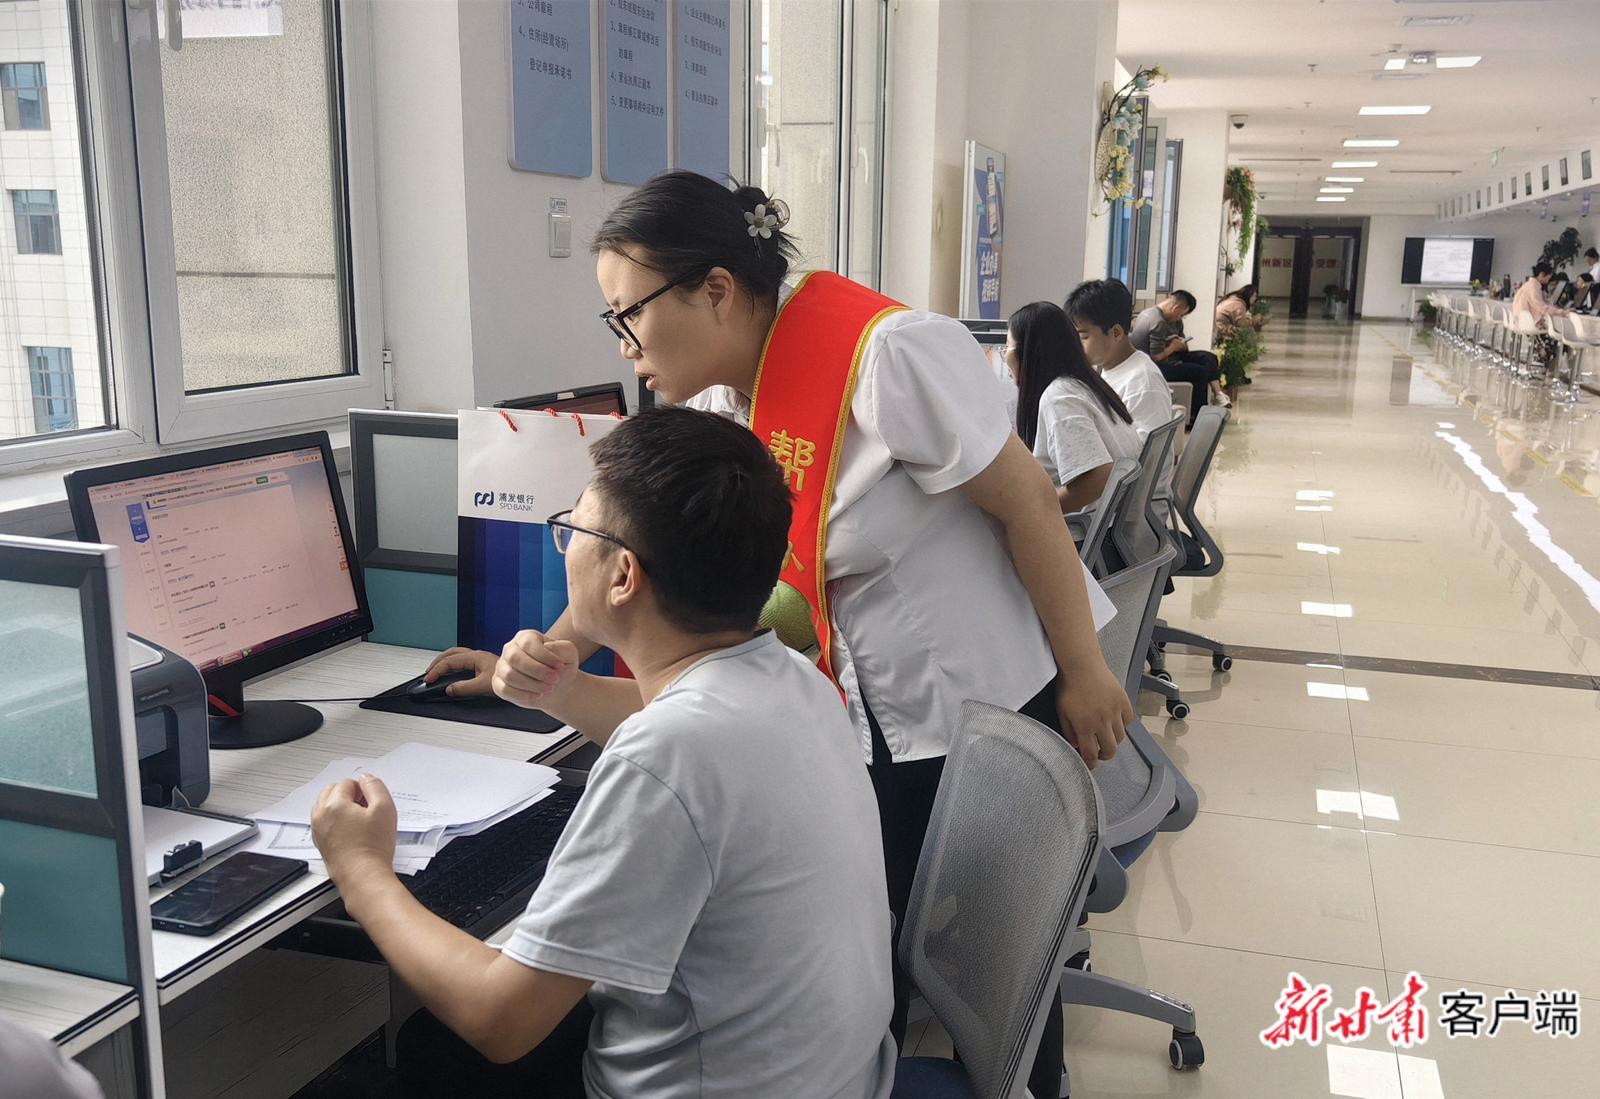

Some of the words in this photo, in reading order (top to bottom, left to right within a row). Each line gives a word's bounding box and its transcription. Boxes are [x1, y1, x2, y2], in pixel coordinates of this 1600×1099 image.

[529, 58, 572, 80] 登记申报承诺书
[499, 492, 535, 505] 浦发银行
[514, 504, 533, 512] BANK
